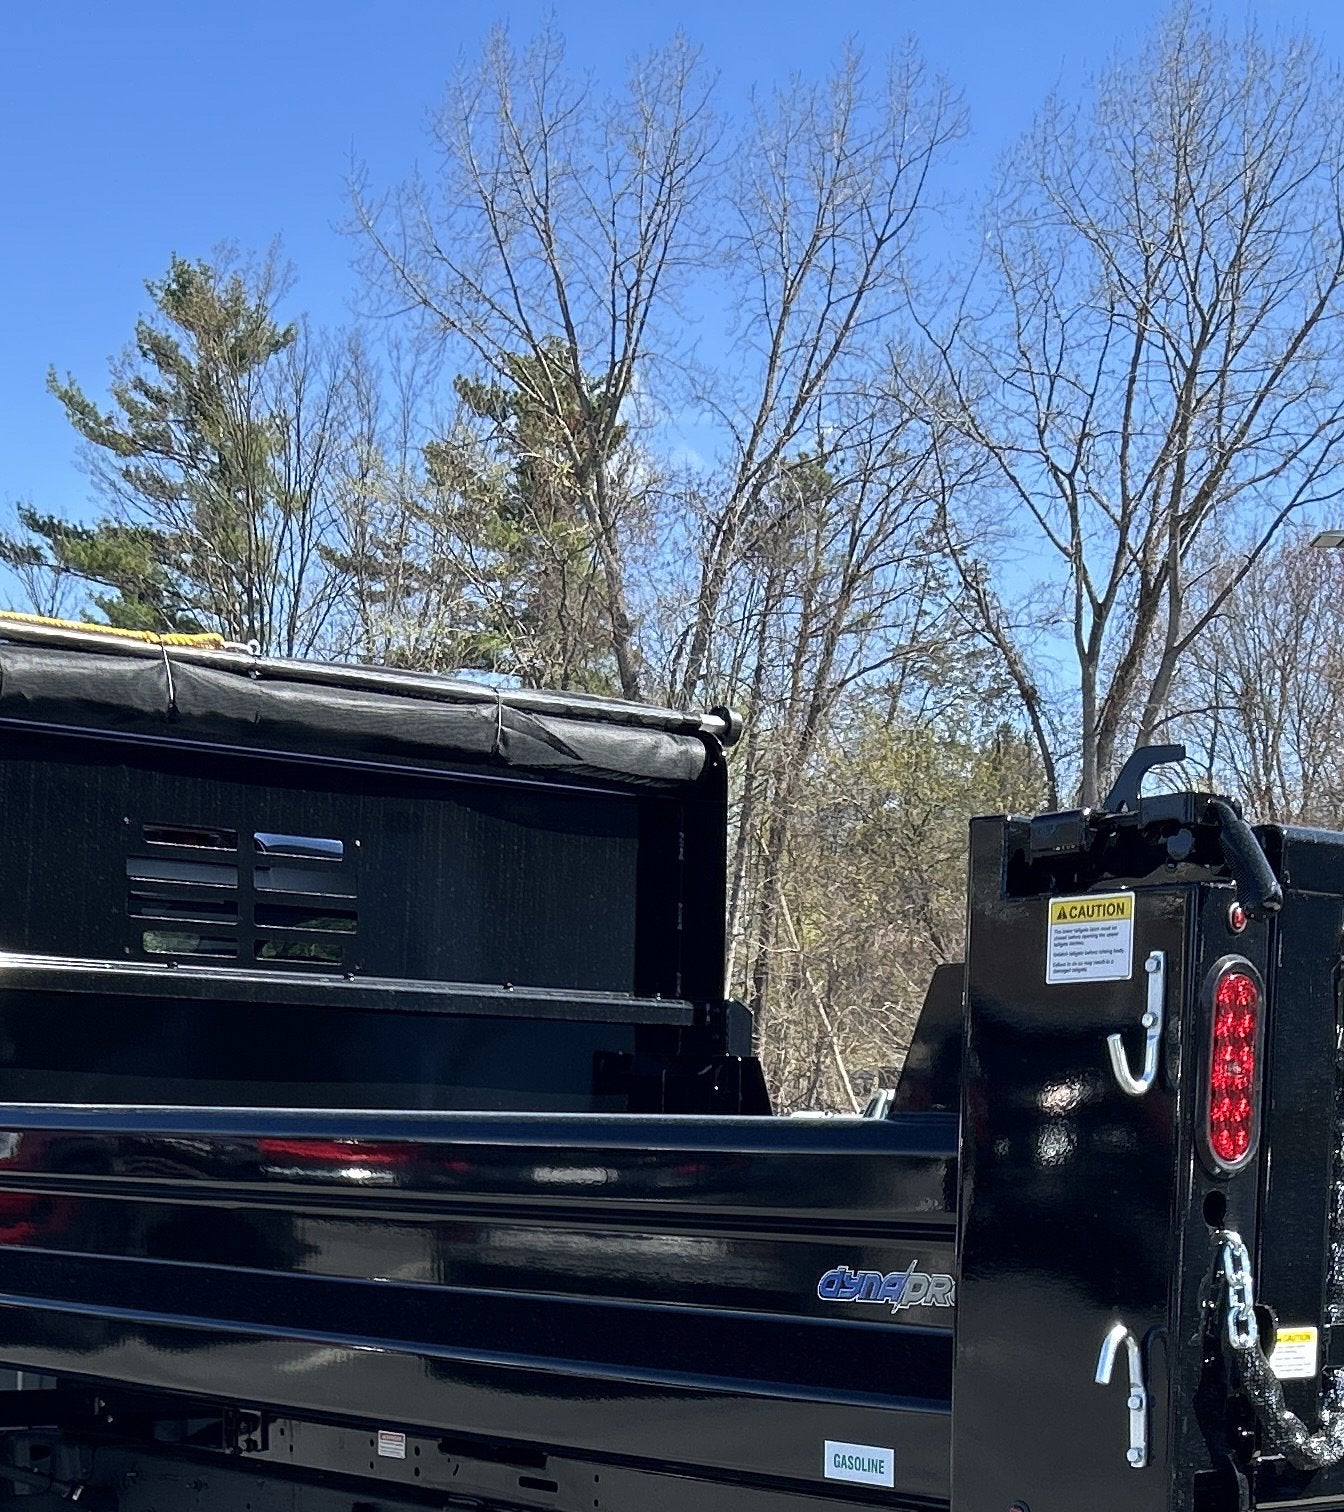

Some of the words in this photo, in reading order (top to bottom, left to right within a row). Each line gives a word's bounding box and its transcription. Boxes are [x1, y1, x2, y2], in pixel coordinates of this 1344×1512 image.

[1069, 902, 1125, 919] CAUTION
[817, 1259, 956, 1315] dynaPR
[833, 1453, 885, 1475] GASOLINE
